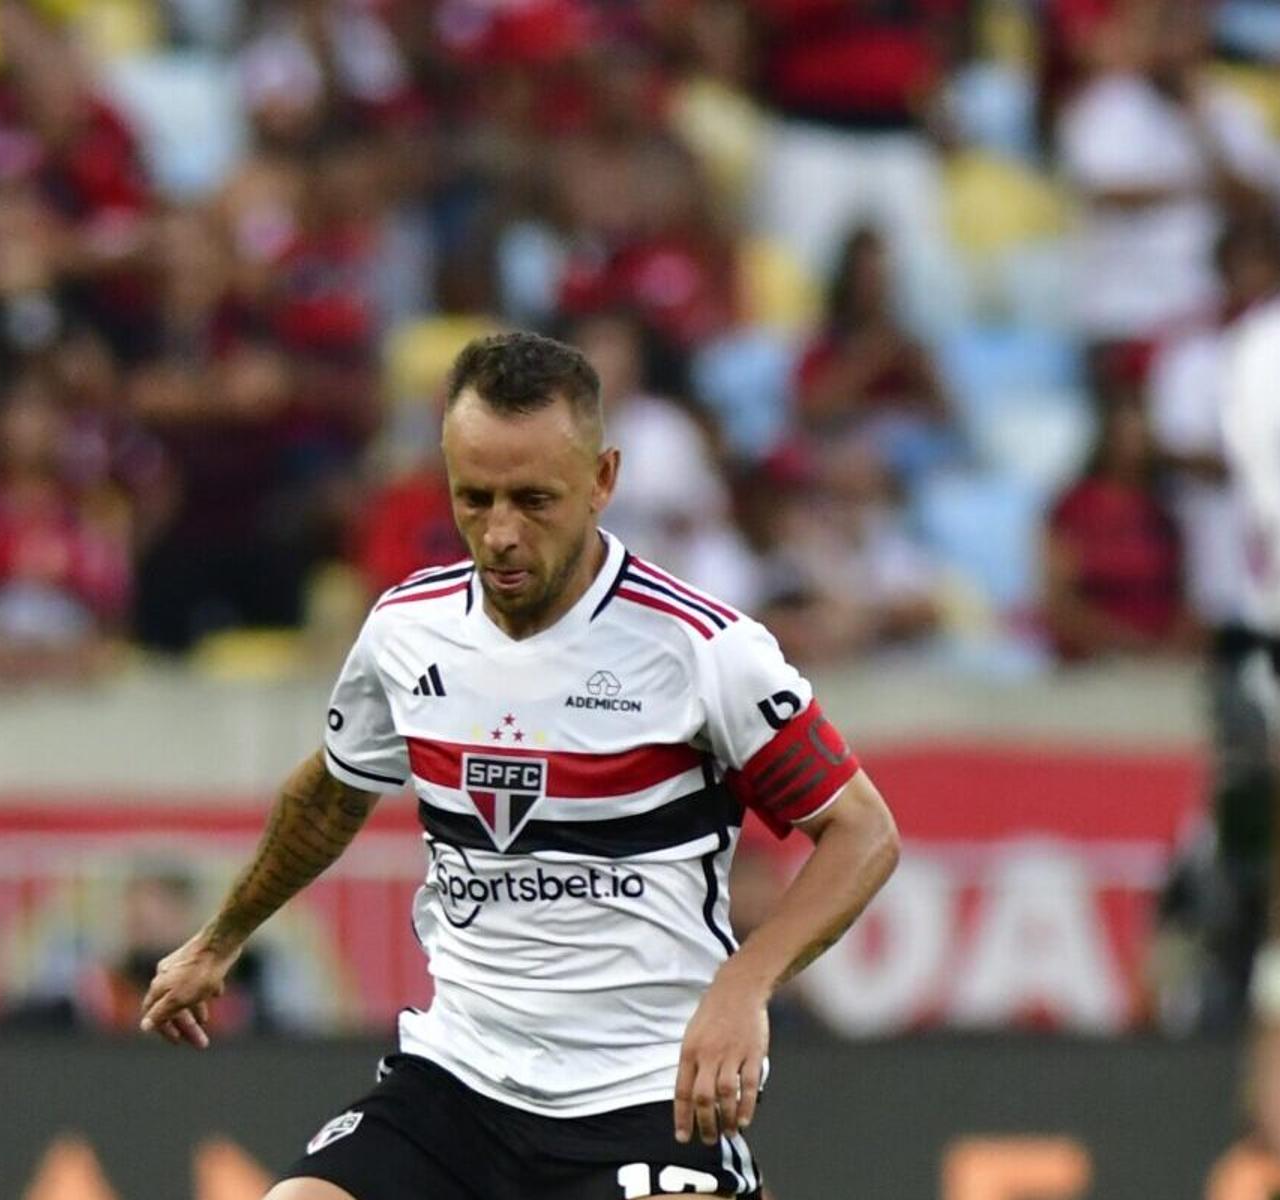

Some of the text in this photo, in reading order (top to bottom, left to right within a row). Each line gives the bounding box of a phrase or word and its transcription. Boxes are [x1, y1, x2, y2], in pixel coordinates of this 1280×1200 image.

[564, 695, 643, 713] ADEMICON
[469, 762, 541, 788] SPFC
[436, 865, 646, 908] Sportsbet.io
